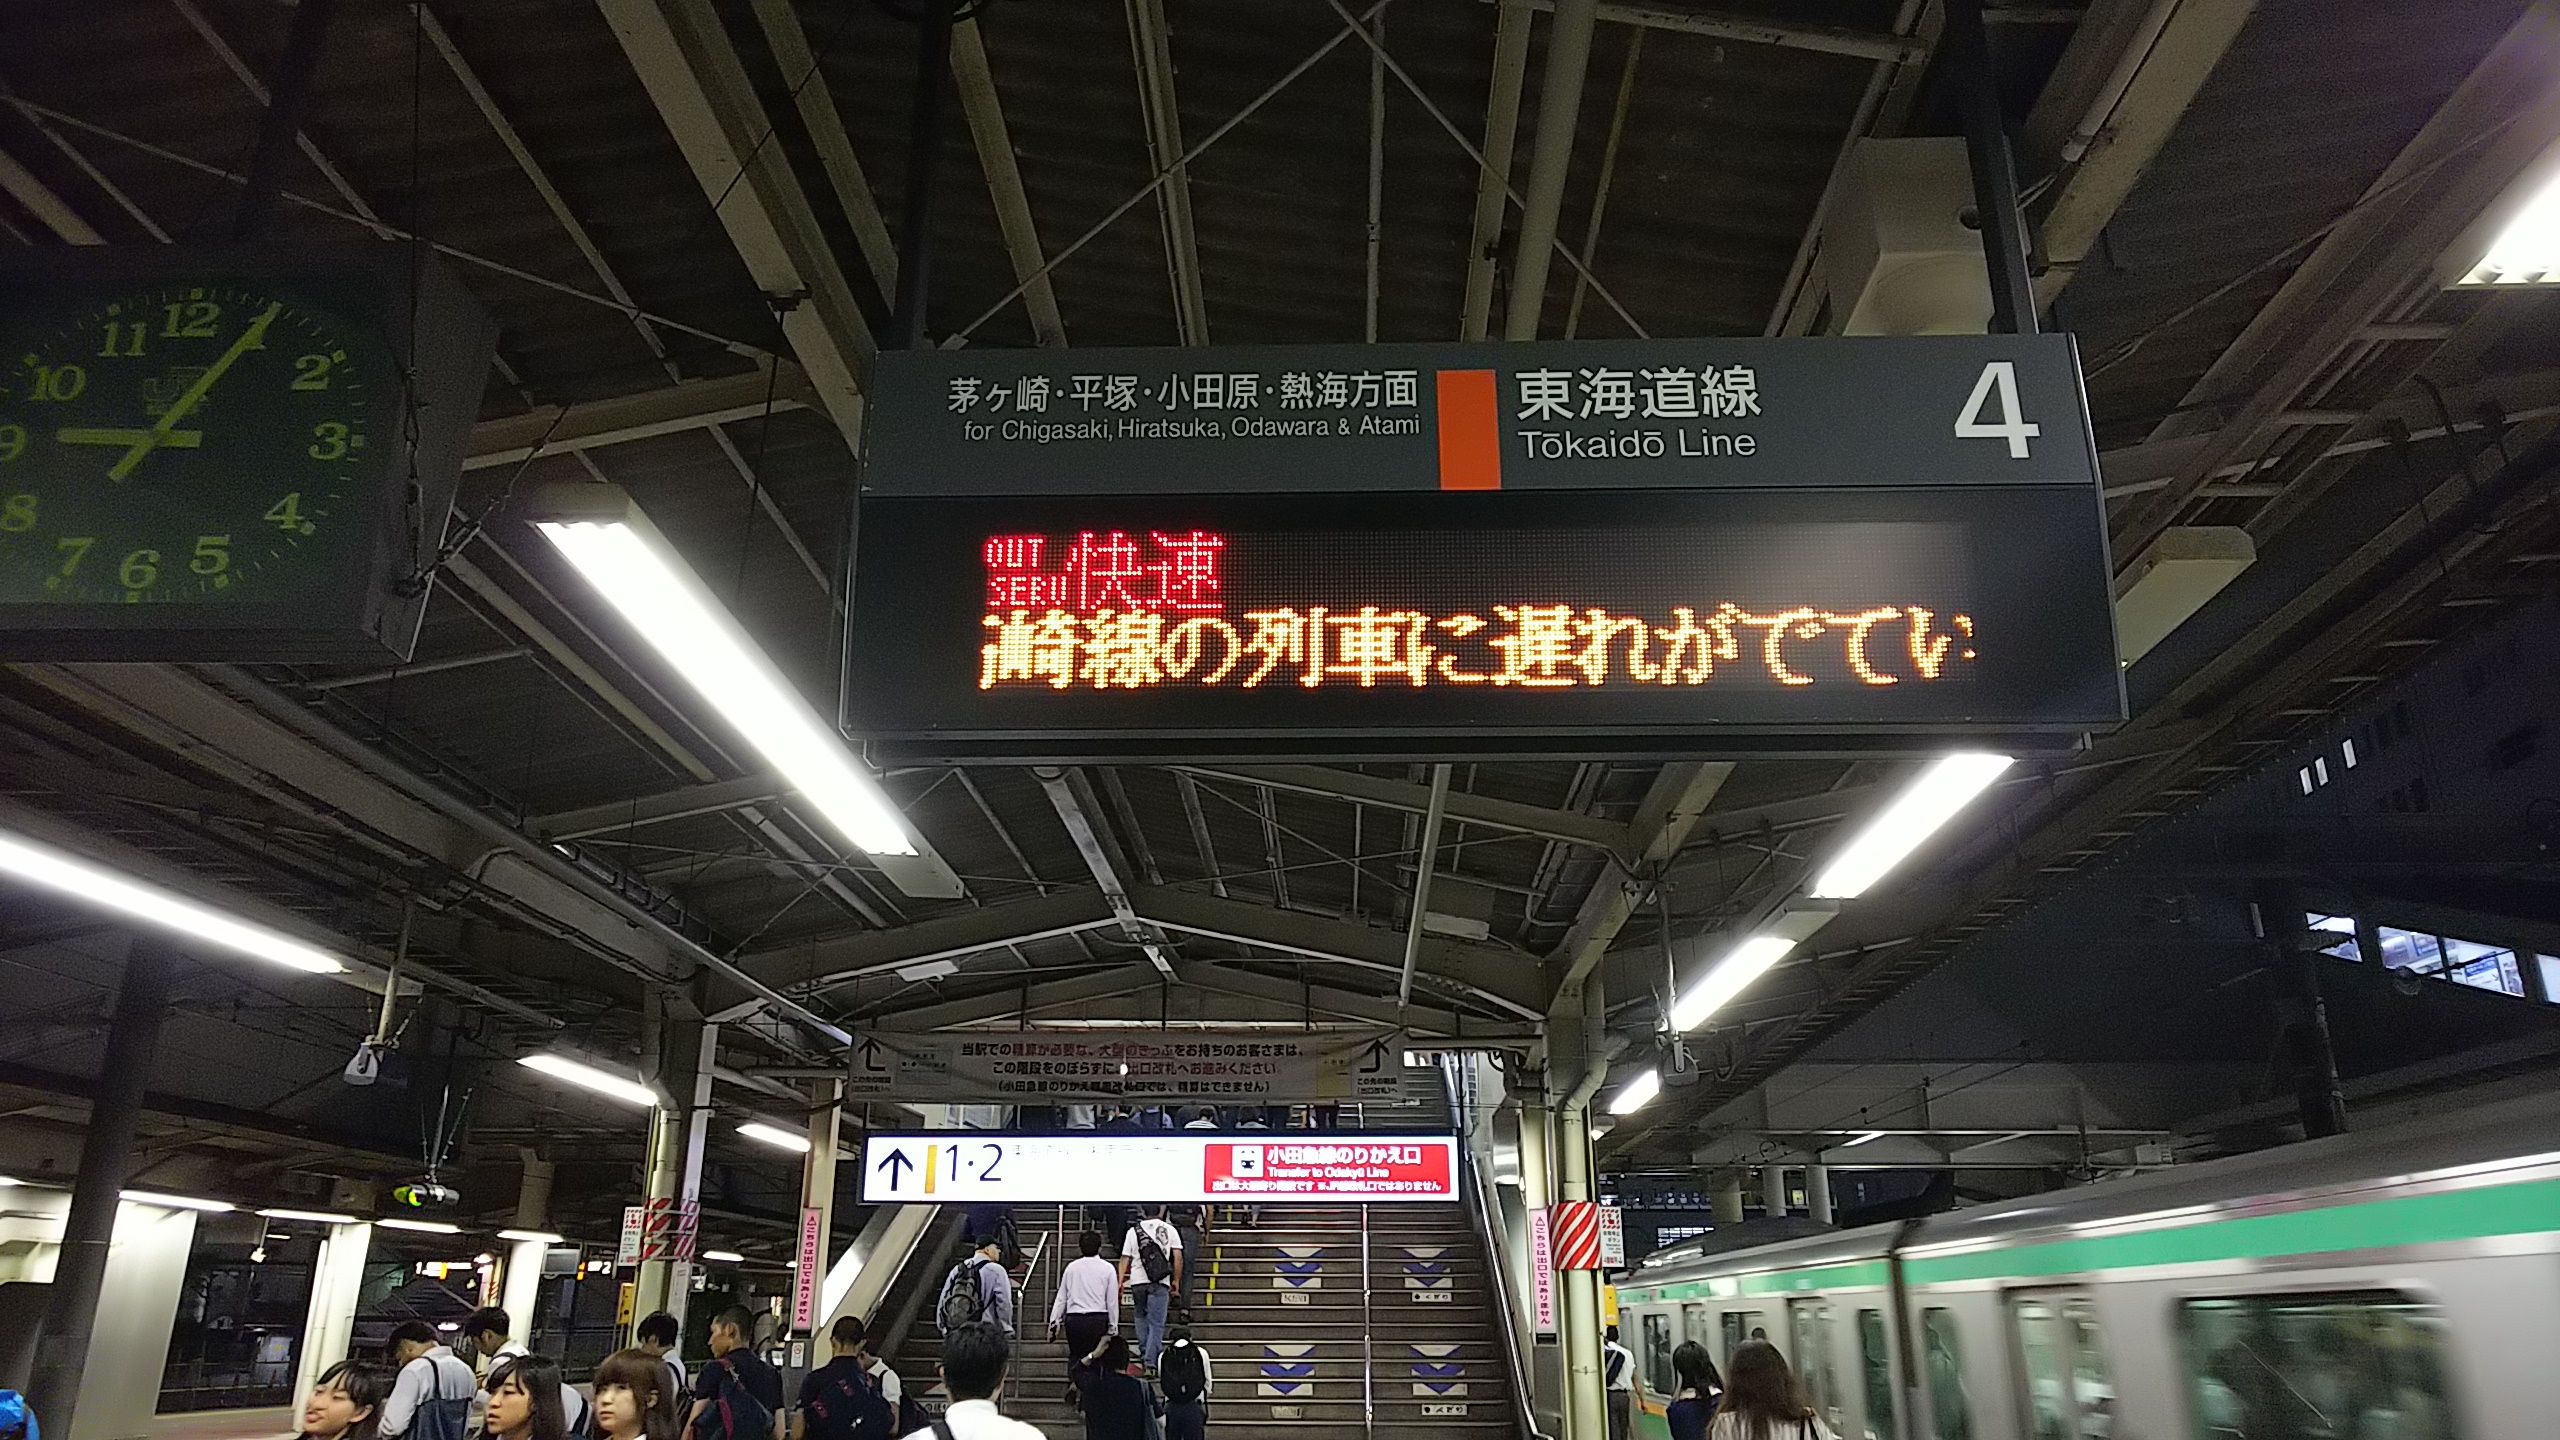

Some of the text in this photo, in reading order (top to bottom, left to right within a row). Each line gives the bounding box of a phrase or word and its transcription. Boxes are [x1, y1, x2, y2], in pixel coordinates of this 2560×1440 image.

[161, 302, 221, 338] 12
[99, 322, 146, 357] 11
[29, 366, 86, 402] 10
[290, 354, 333, 391] 2
[948, 370, 1418, 414] 茅ヶ崎・平塚・小田原・熱海方面
[1516, 365, 1762, 421] 東海道線
[1955, 361, 2041, 459] 4
[307, 422, 349, 460] 3
[964, 414, 1420, 444] for Chigasaki, Hiratsuka, Odawara & Atami
[1518, 428, 1756, 459] Tōkaidō Line
[1, 494, 37, 532] 8
[264, 492, 304, 530] 4
[55, 537, 96, 577] 7
[120, 549, 161, 589] 6
[189, 534, 231, 574] 5
[986, 538, 1043, 568] OUT
[1066, 530, 1224, 609] 快速
[1267, 1146, 1422, 1165] 小田急線のりかえ口
[1267, 1167, 1310, 1178] Transfer
[1312, 1167, 1323, 1178] to
[1535, 1227, 1551, 1325] こちらは出口ではありません
